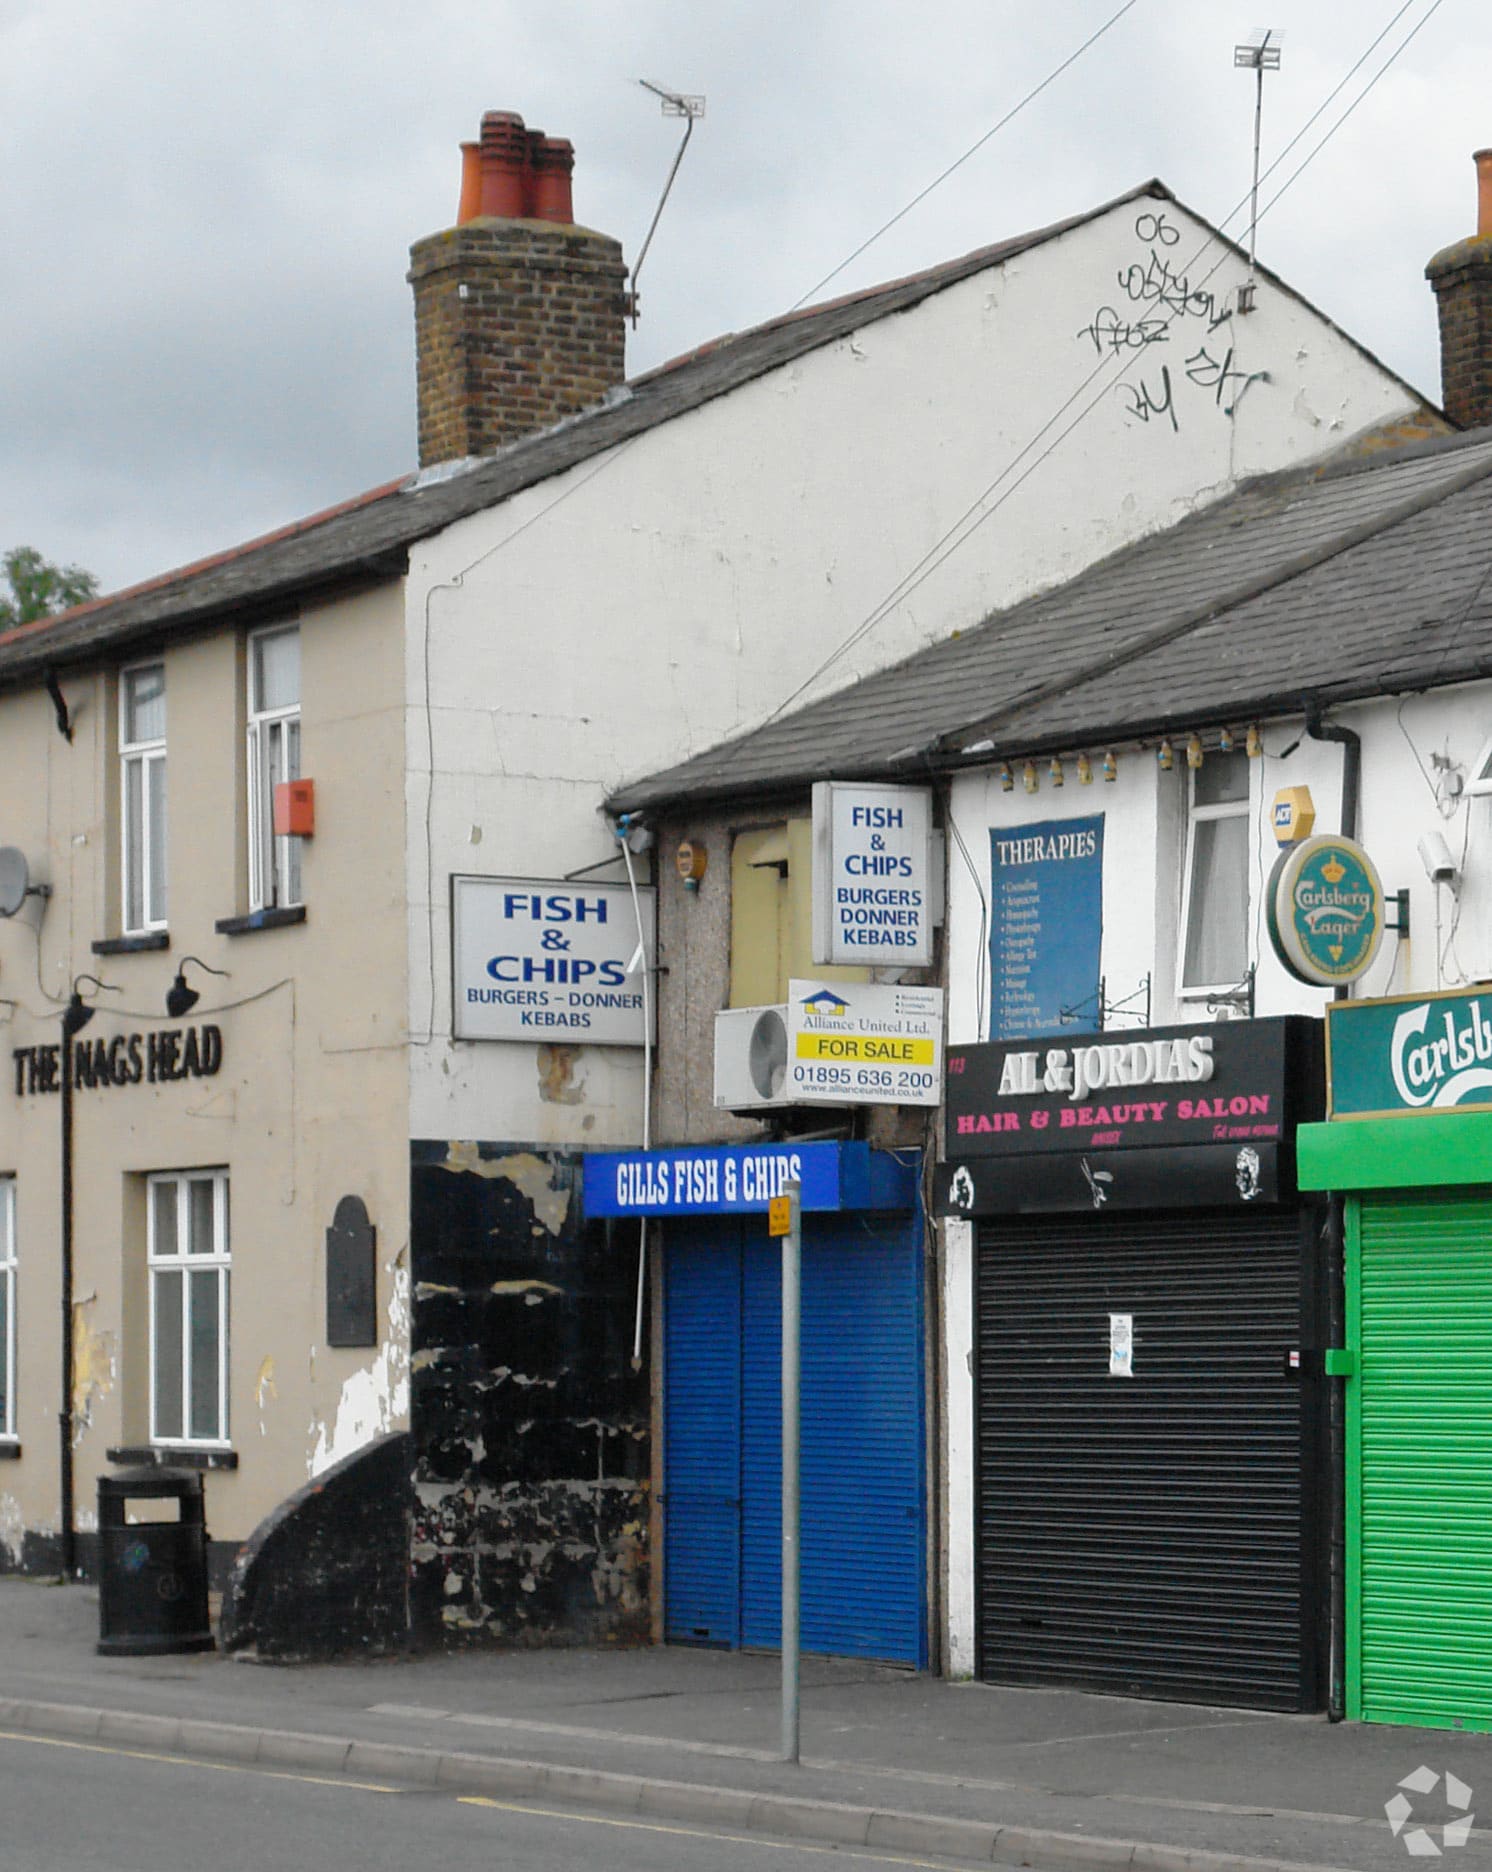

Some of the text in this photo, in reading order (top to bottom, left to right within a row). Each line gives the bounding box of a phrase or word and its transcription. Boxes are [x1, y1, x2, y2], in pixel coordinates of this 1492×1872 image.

[852, 806, 904, 829] FISH
[870, 833, 886, 851] &
[997, 830, 1097, 866] THERAPIES
[844, 855, 913, 877] CHIPS
[837, 887, 922, 906] BURGERS
[1295, 880, 1370, 915] Carlsberg
[504, 893, 608, 924] FISH
[840, 908, 919, 926] DONNER
[540, 928, 571, 951] &
[843, 929, 918, 946] KEBABS
[1311, 919, 1359, 944] Lager
[486, 955, 626, 987] CHIPS
[467, 988, 549, 1006] BURGERS
[569, 992, 643, 1009] DONNER
[521, 1010, 591, 1027] KEBABS
[803, 1015, 930, 1035] Alliance United Ltd.
[13, 1024, 223, 1096] THE NAGS HEAD
[818, 1039, 914, 1060] FOR SALE
[1391, 1000, 1492, 1107] Carlsb
[794, 1066, 933, 1089] 01895 636 200
[802, 1083, 924, 1098] www.allianceunited.co.uk
[957, 1095, 1270, 1134] HAIR & BEAUTY SALON
[617, 1154, 801, 1206] GILLS FISH & CHIPS
